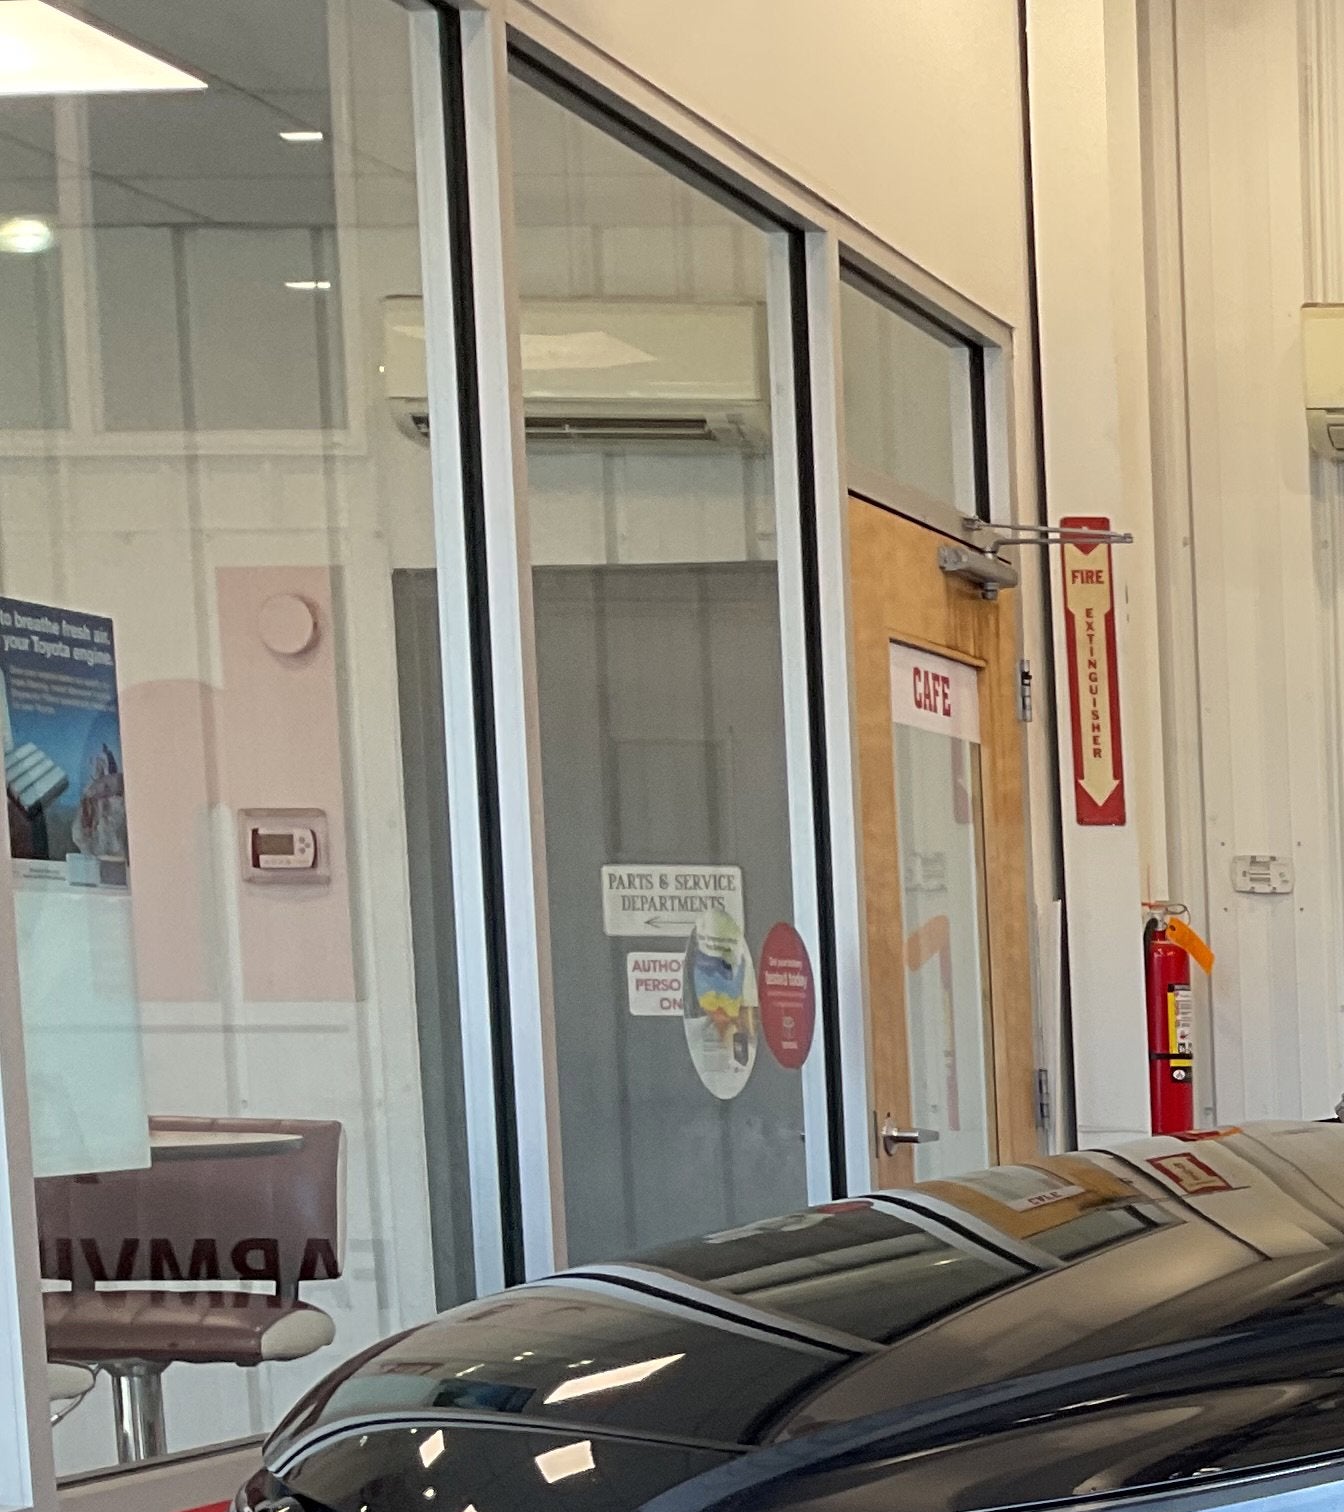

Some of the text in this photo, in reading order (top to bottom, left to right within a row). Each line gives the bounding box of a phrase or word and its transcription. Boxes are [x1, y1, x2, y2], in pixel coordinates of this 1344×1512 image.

[1071, 569, 1105, 584] FIRE
[30, 635, 71, 659] Toyota
[913, 666, 951, 718] CAFE
[1085, 607, 1103, 759] EXTINGUISHER
[607, 873, 737, 891] PARTS & SERVICE
[620, 894, 726, 912] DEPARTMENTS
[631, 959, 683, 973] AUTHO
